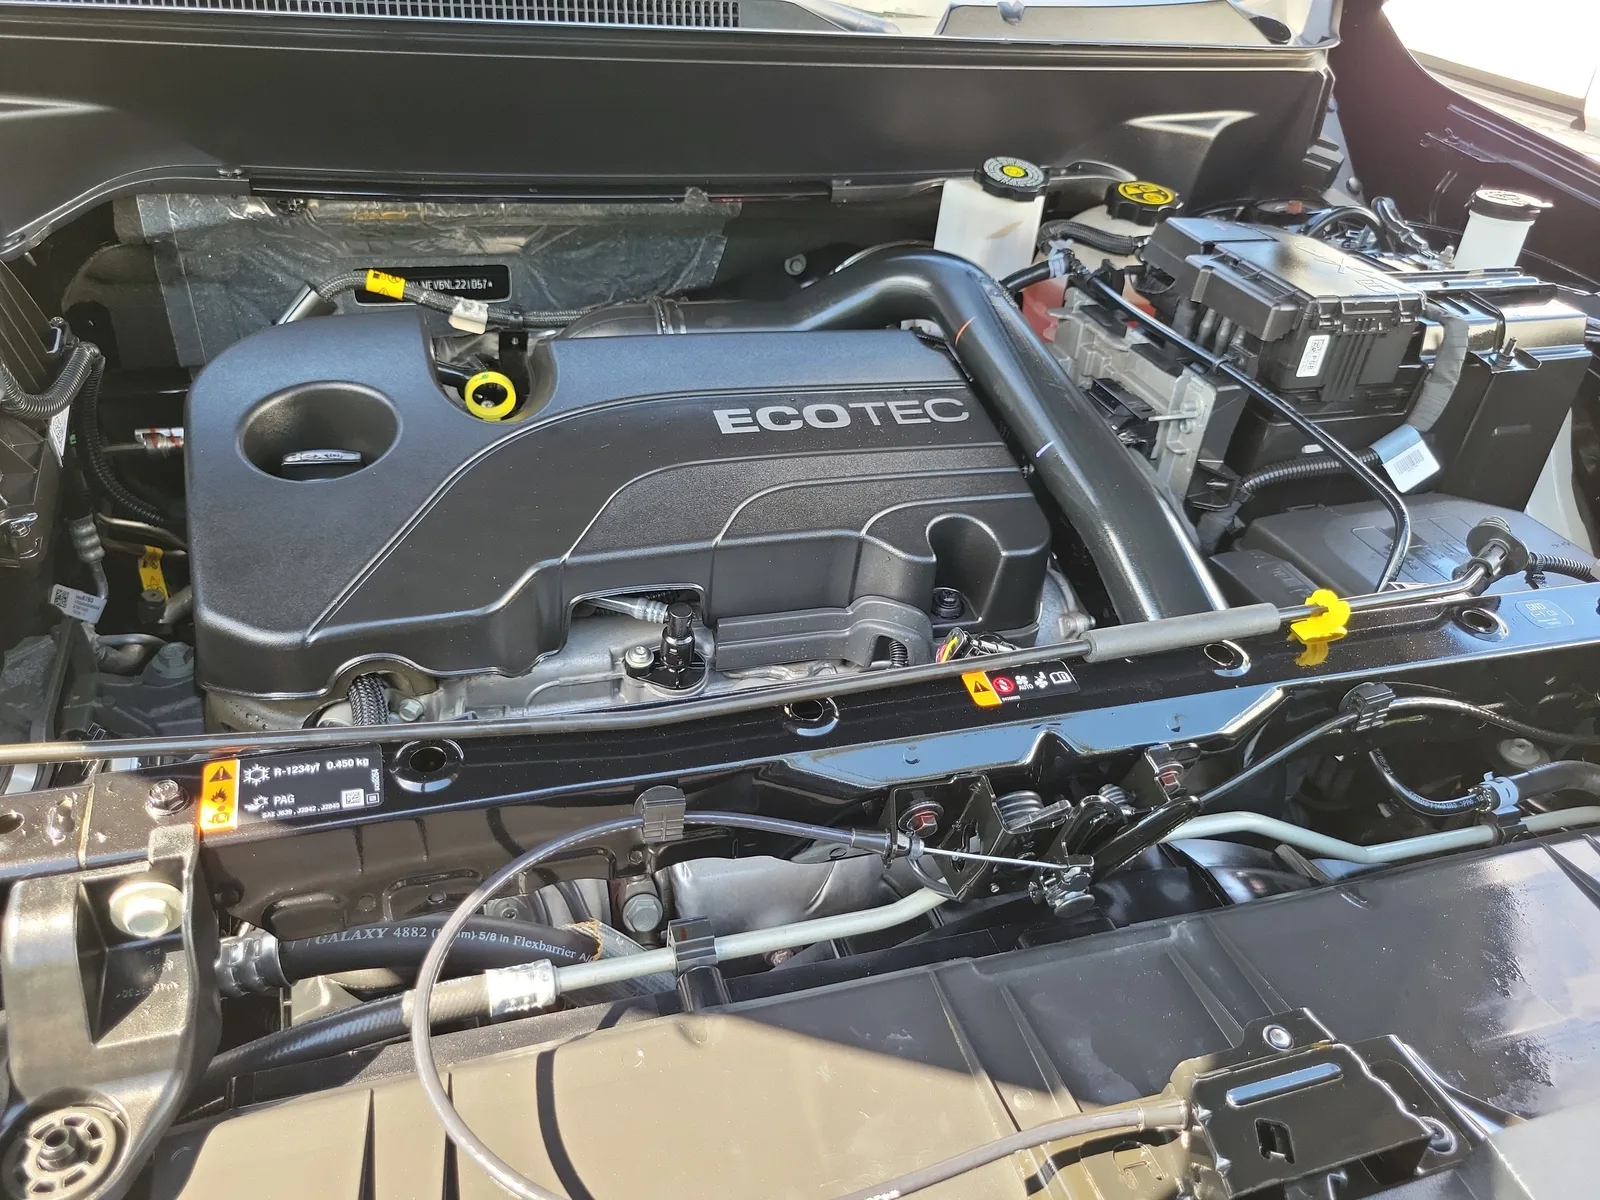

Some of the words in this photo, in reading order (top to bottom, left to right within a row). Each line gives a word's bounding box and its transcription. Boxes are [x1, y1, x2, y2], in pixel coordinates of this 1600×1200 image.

[712, 398, 970, 434] ECOTEC
[1019, 683, 1034, 691] AUTO
[273, 762, 320, 778] R-1234yf
[325, 758, 354, 770] 0.450
[355, 757, 370, 768] kg
[273, 794, 295, 806] PAG
[315, 926, 390, 945] GALAXY
[392, 926, 427, 938] 4882
[478, 930, 497, 942] 5/8
[499, 933, 509, 944] in
[513, 935, 576, 960] Flexbarrier
